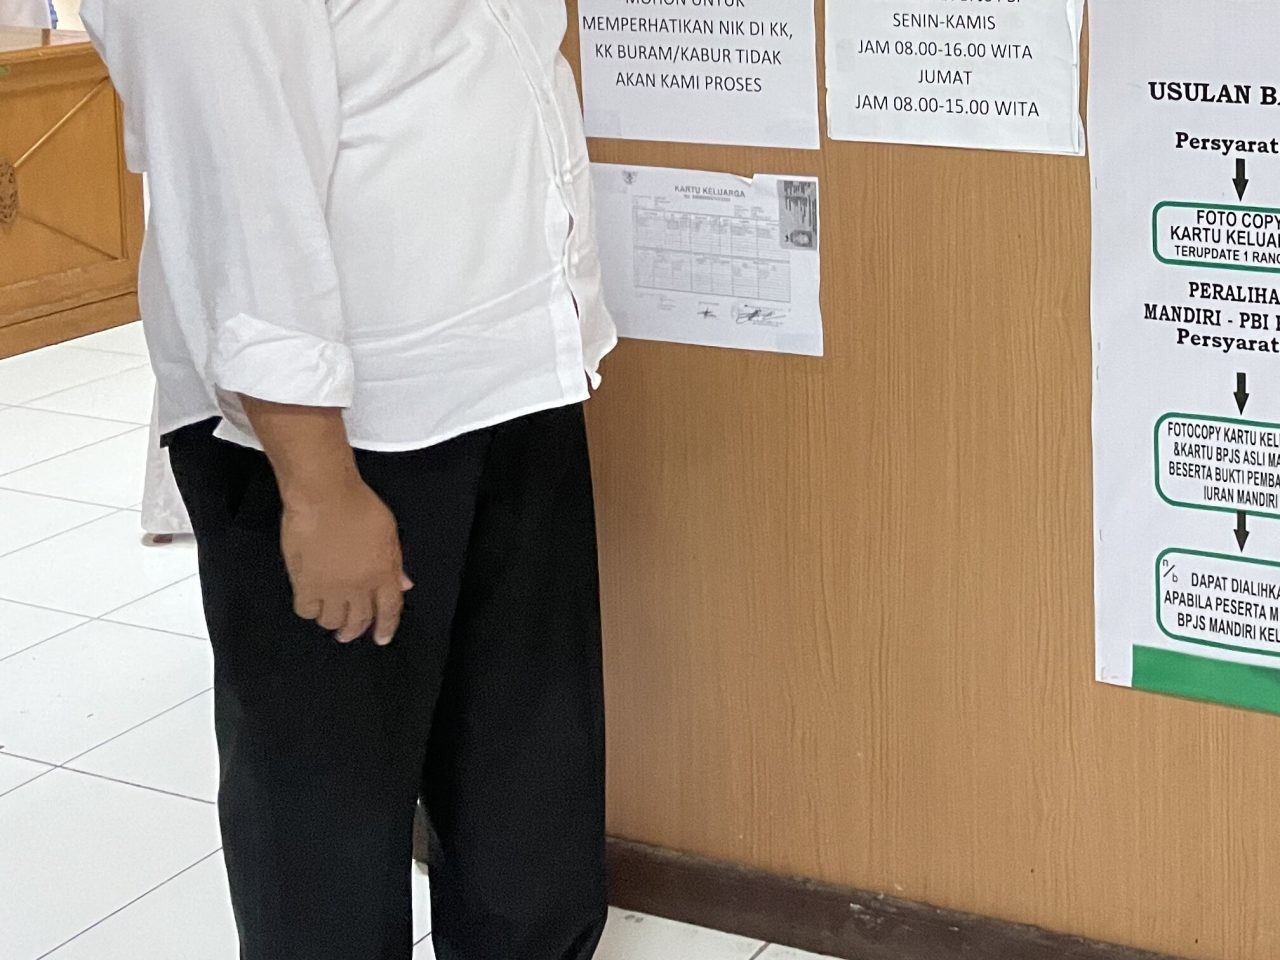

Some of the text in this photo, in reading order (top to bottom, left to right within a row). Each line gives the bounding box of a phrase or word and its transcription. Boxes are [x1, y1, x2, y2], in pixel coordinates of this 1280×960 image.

[583, 16, 793, 40] MEMPERHATIKAN NIK DI KK,
[893, 13, 996, 30] SENIN-KAMIS
[595, 44, 782, 65] KK BURAM/KABUR TIDAK
[858, 40, 1032, 59] JAM 08.00-16.00 WITA
[616, 72, 762, 92] AKAN KAMI PROSES
[918, 70, 972, 84] JUMAT
[1148, 82, 1251, 104] USULAN
[856, 95, 1039, 117] JAM 08.00-15.00 WITA
[703, 187, 745, 198] KELUARGA
[1197, 210, 1237, 227] FOTO
[1171, 226, 1221, 243] KARTU
[1174, 246, 1240, 261] TERUPDATE
[1244, 252, 1248, 261] 1
[1144, 303, 1221, 326] MANDIRI
[1240, 312, 1269, 330] PBI
[1168, 422, 1221, 441] FOTOCOPY
[1224, 427, 1256, 446] KARTU
[1173, 442, 1213, 461] &KARTU
[1216, 447, 1240, 464] BPJS
[1243, 451, 1266, 467] ASLI
[1169, 461, 1213, 480] BESERTA
[1215, 467, 1244, 484] BUKTI
[1204, 486, 1278, 508] IURAN MANDIRI
[1191, 573, 1227, 592] DAPAT
[1164, 590, 1212, 610] APABILA
[1215, 597, 1266, 619] PESERTA
[1178, 613, 1206, 631] BPJS
[1209, 618, 1256, 639] MANDIRI
